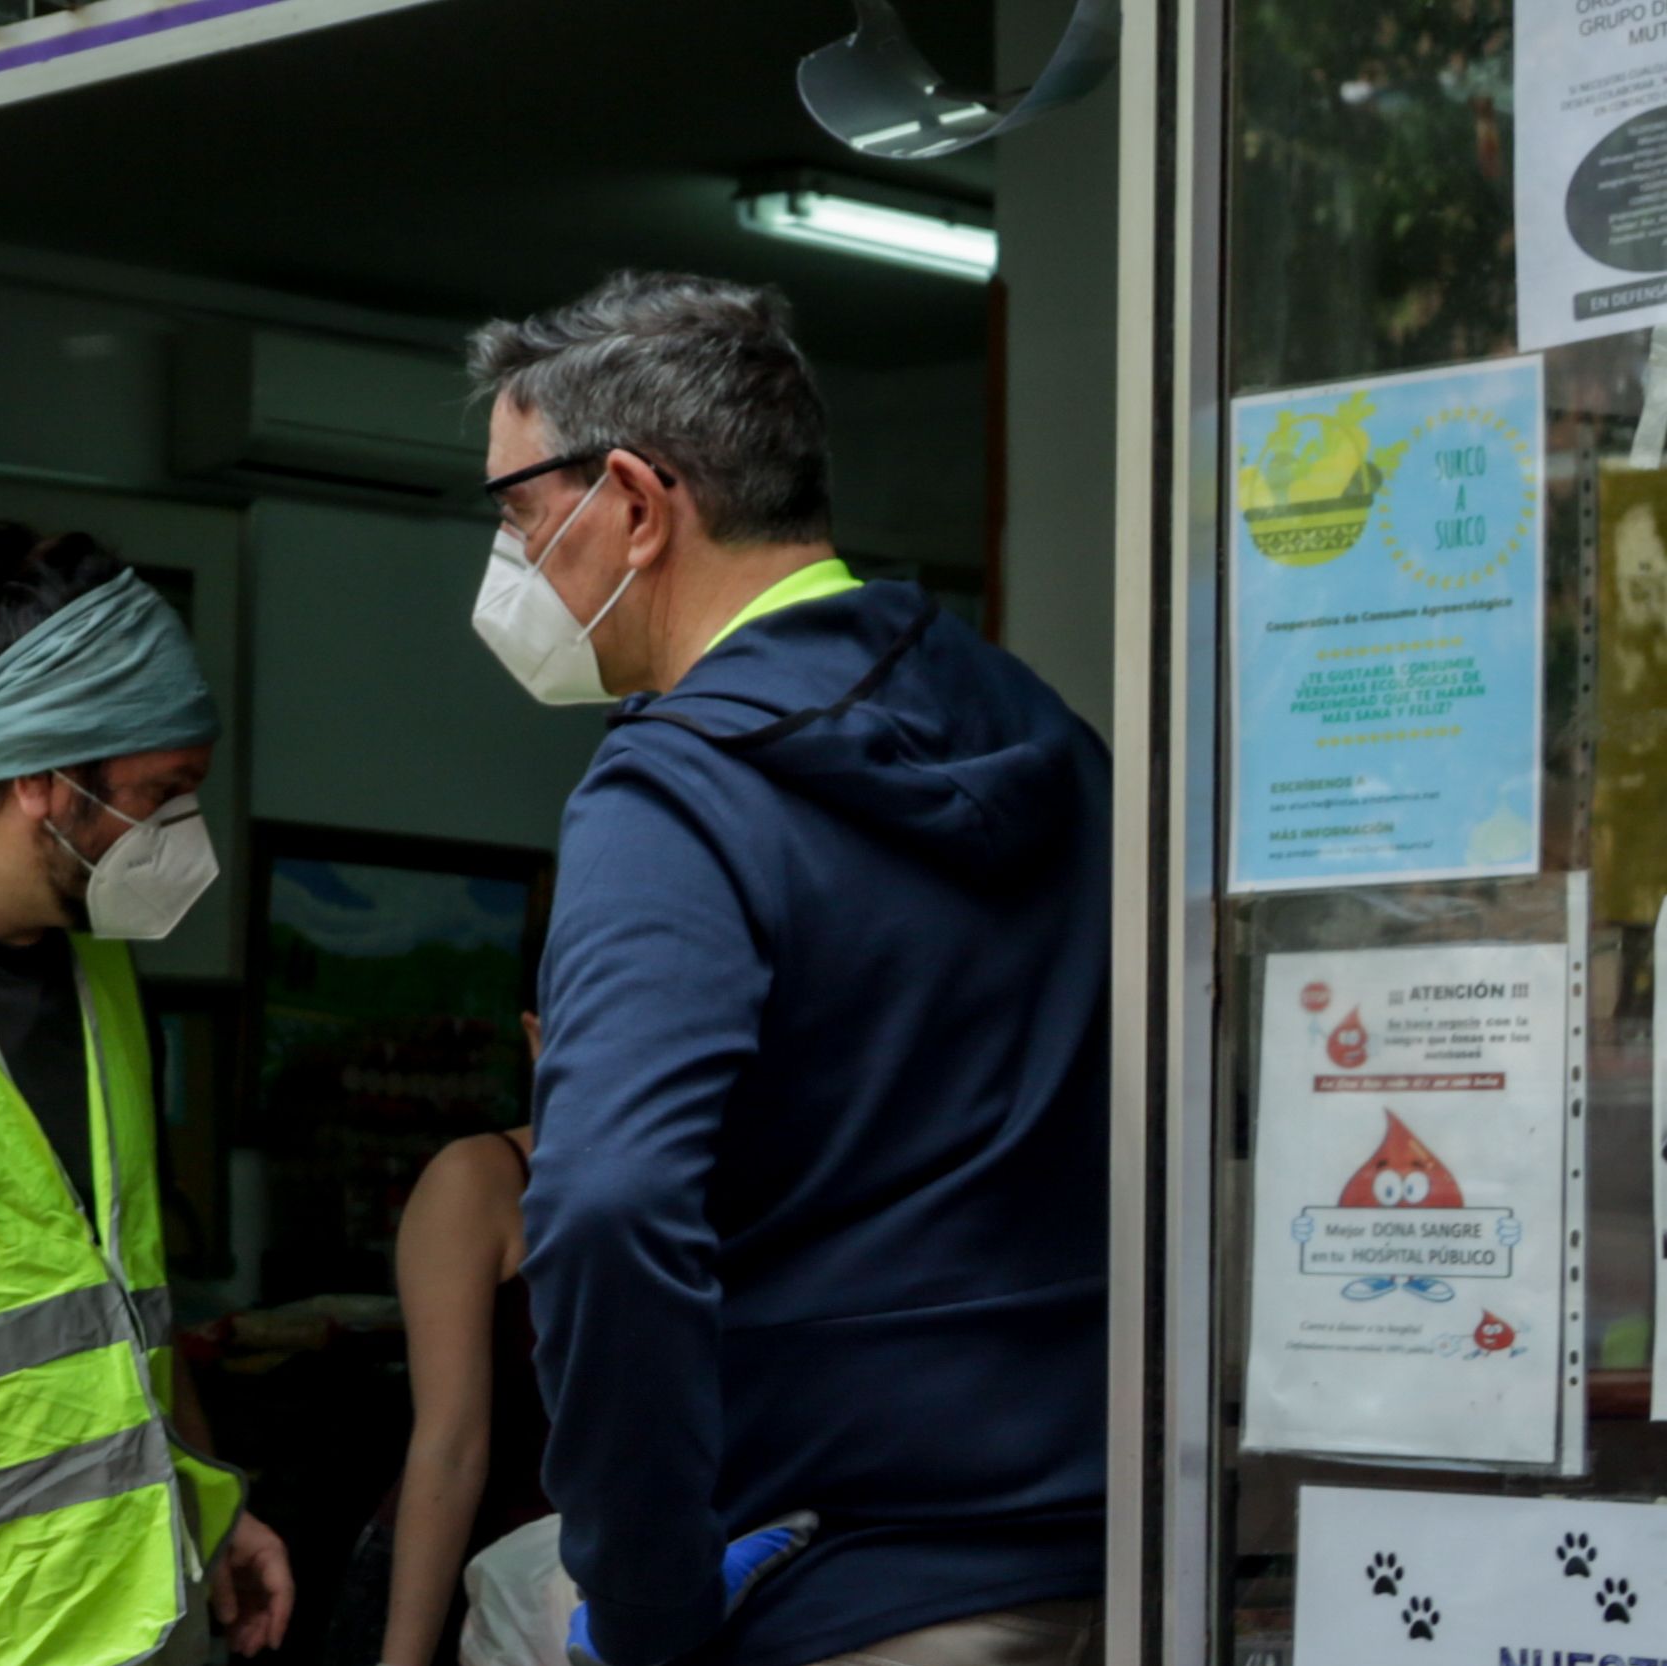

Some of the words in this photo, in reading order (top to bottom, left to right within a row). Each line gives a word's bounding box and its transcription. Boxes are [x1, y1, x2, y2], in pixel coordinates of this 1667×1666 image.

[1579, 4, 1646, 36] GRUPO
[1652, 0, 1667, 18] D
[1434, 444, 1486, 482] SURCO
[1454, 483, 1466, 513] A
[1434, 515, 1486, 551] SURCO
[1266, 615, 1339, 633] Cooperativa
[1343, 612, 1358, 625] de
[1361, 606, 1417, 623] Consumo
[1327, 661, 1395, 682] GUSTARÍA
[1400, 655, 1475, 677] CONSUMIR
[1295, 680, 1366, 701] VERDURAS
[1371, 670, 1458, 693] ECOLÓGICAS
[1462, 669, 1481, 683] DE
[1290, 694, 1380, 715] PROXIMIDAD
[1383, 691, 1412, 705] QUE
[1416, 688, 1431, 701] TE
[1322, 707, 1350, 724] MÁS
[1355, 706, 1391, 722] SANA
[1397, 705, 1404, 717] Y
[1270, 827, 1297, 841] MÁS
[1301, 820, 1394, 839] INFORMACIÓN
[1409, 980, 1505, 1001] ATENCIÓN
[1486, 1017, 1511, 1027] con
[1427, 1034, 1446, 1045] que
[1325, 1224, 1367, 1240] Mejor
[1372, 1222, 1416, 1238] DONA
[1420, 1222, 1482, 1240] SANGRE
[1310, 1252, 1329, 1263] en
[1331, 1250, 1345, 1263] tu
[1351, 1248, 1424, 1265] HOSPITAL
[1428, 1245, 1496, 1265] PÚBLICO
